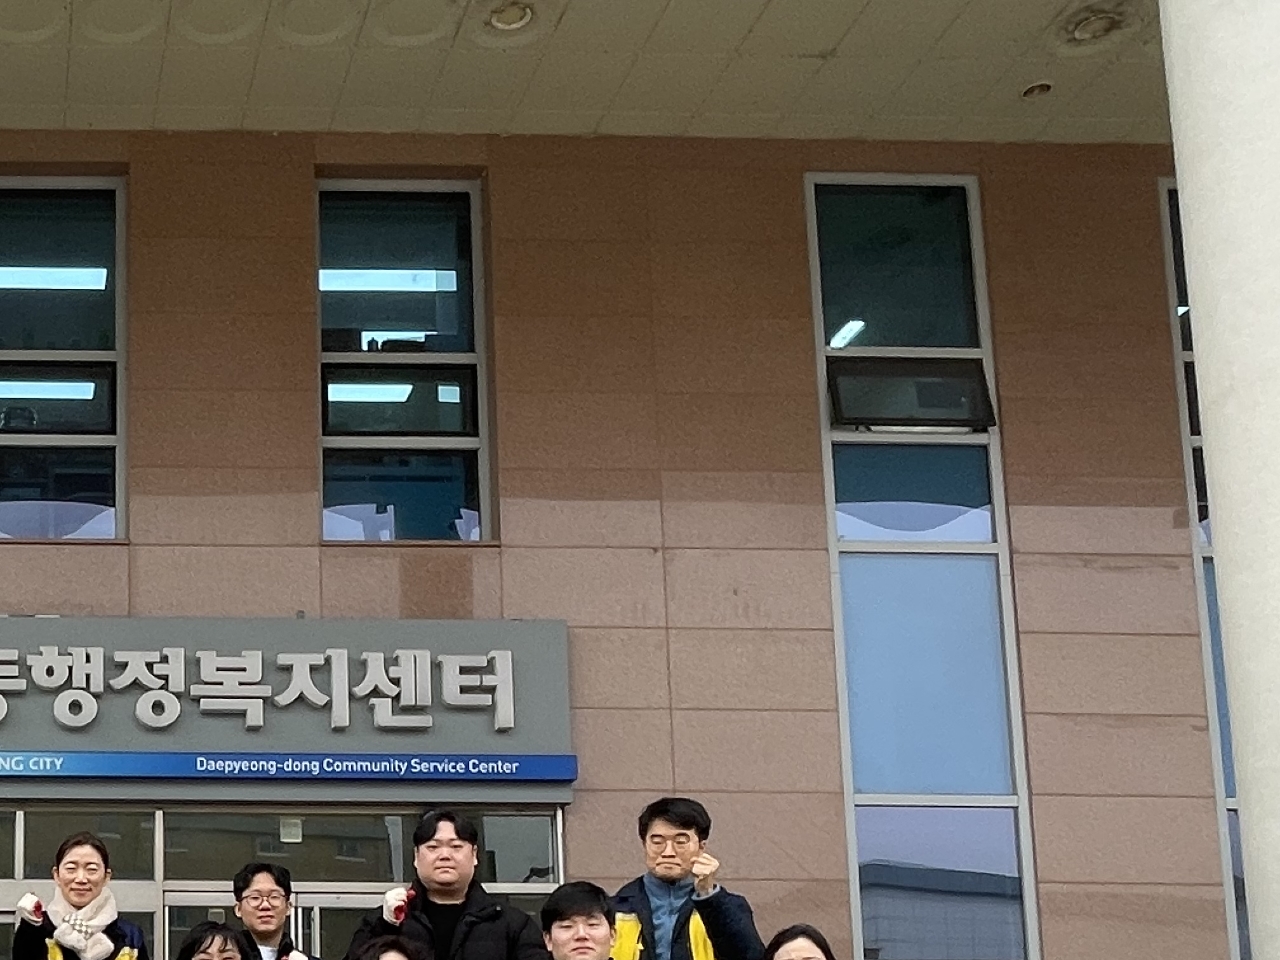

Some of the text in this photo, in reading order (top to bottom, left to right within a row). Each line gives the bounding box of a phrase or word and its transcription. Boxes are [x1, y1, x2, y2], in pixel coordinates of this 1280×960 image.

[29, 756, 64, 771] CITY
[196, 756, 520, 776] Daepyeong-dong Community Service Center
